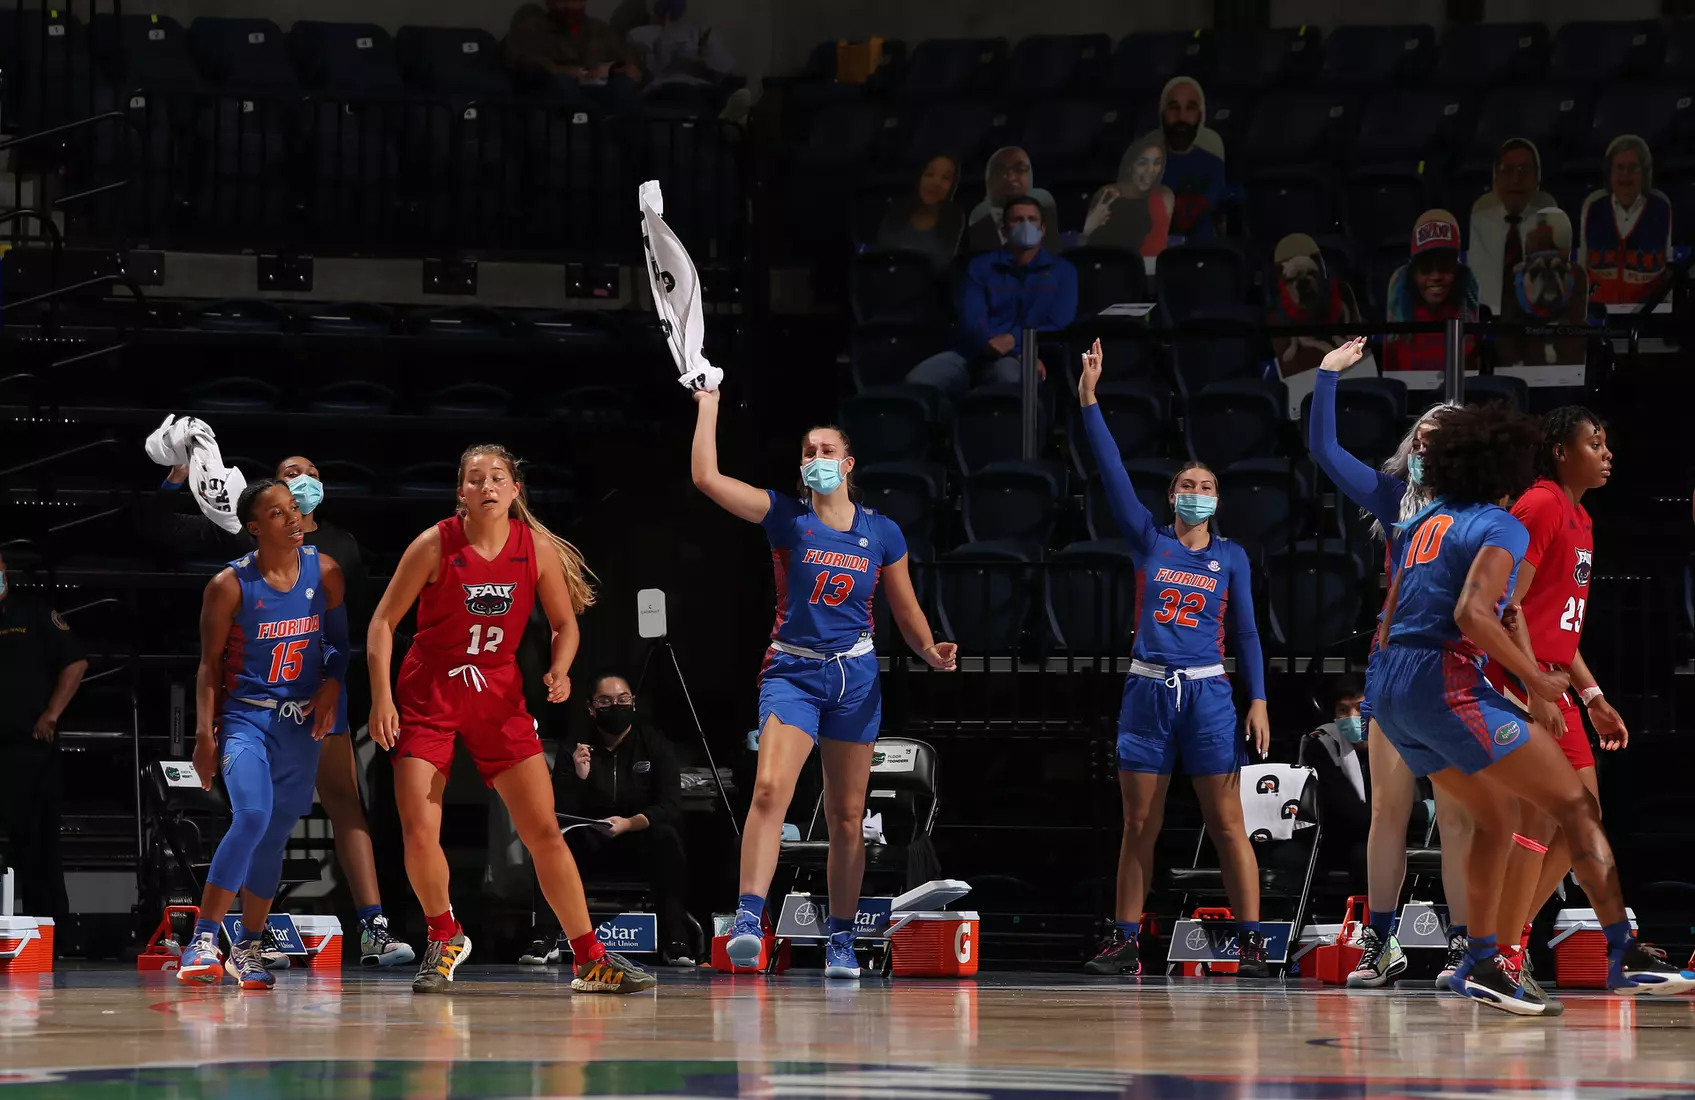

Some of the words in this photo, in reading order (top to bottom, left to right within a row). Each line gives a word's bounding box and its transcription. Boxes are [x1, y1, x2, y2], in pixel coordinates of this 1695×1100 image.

[1404, 514, 1454, 568] 10
[802, 549, 869, 573] FLORIDA
[467, 584, 515, 600] FAU
[809, 570, 855, 607] 13
[1153, 568, 1218, 592] FLORIDA
[1153, 588, 1206, 628] 32
[256, 615, 320, 640] FLORIDA
[466, 624, 504, 655] 12
[267, 639, 310, 683] 15
[594, 921, 639, 940] Star
[954, 922, 971, 964] G
